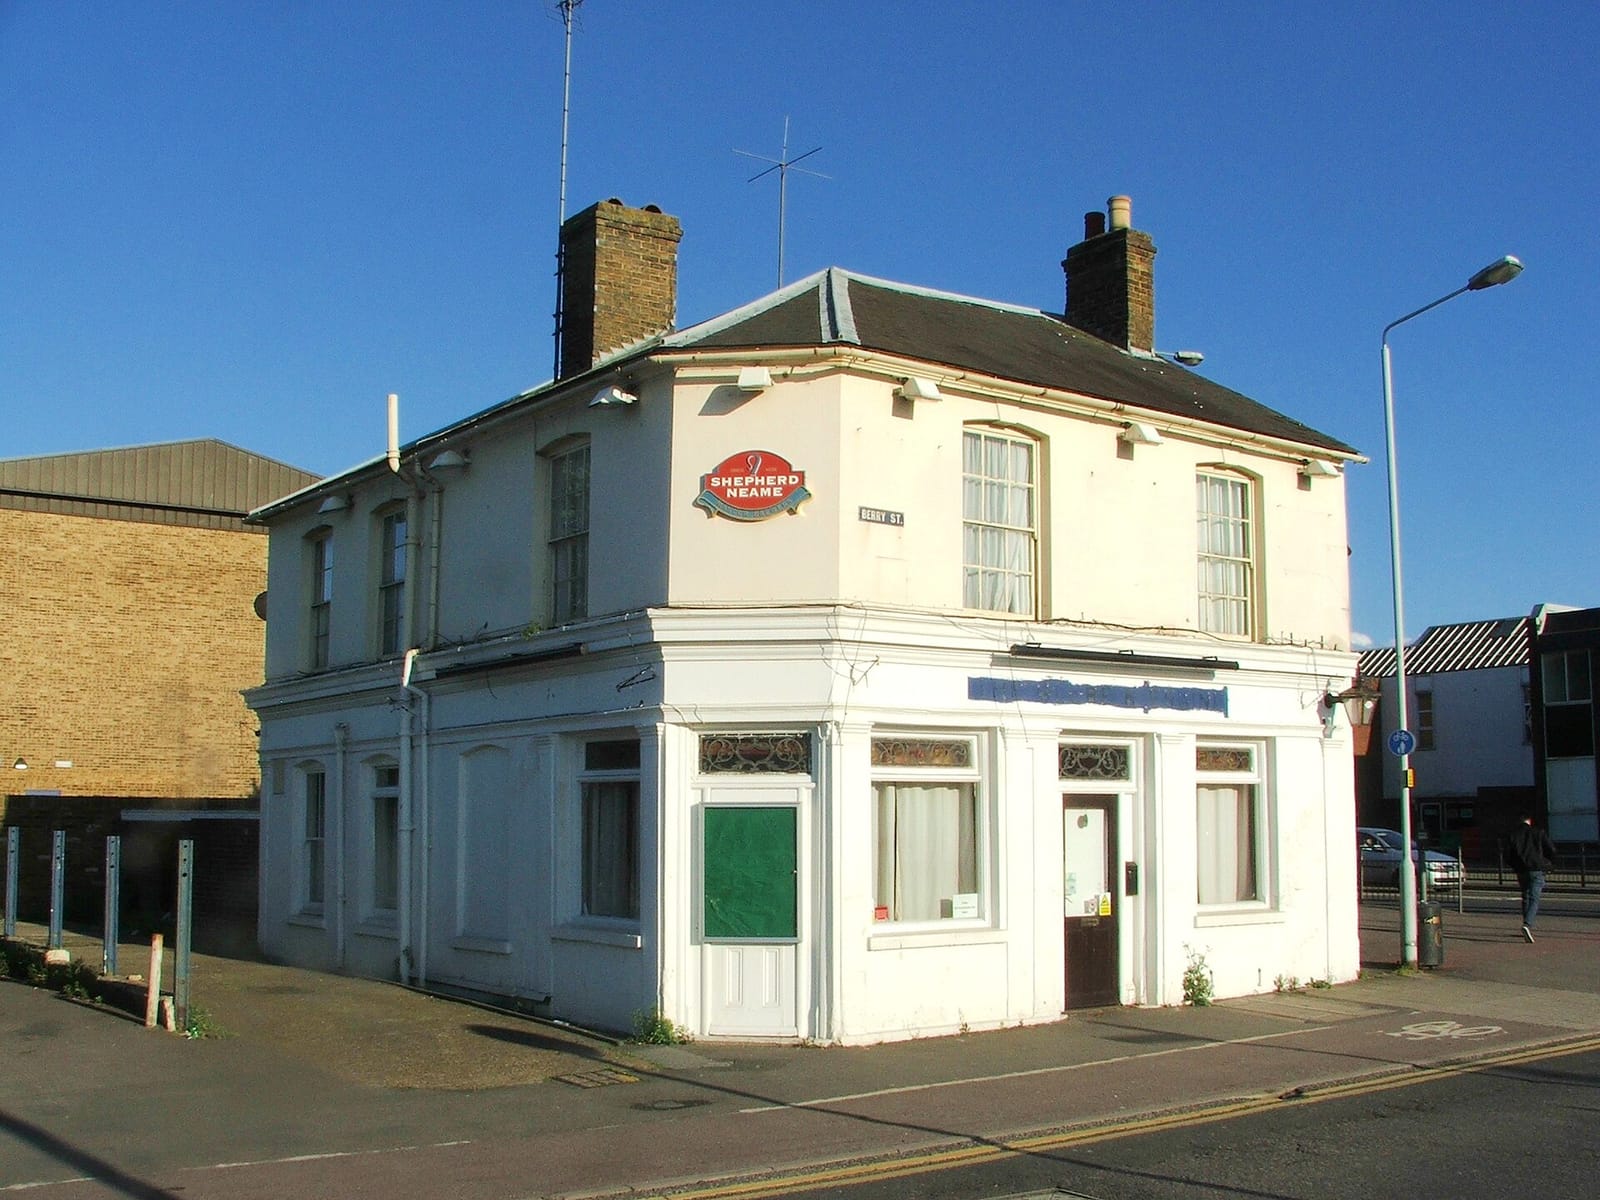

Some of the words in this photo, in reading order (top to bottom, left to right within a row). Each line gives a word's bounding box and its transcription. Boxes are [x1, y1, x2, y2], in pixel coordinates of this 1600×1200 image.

[711, 475, 799, 487] SHEPHERD
[726, 487, 783, 498] NEAME
[861, 508, 886, 522] BERRY
